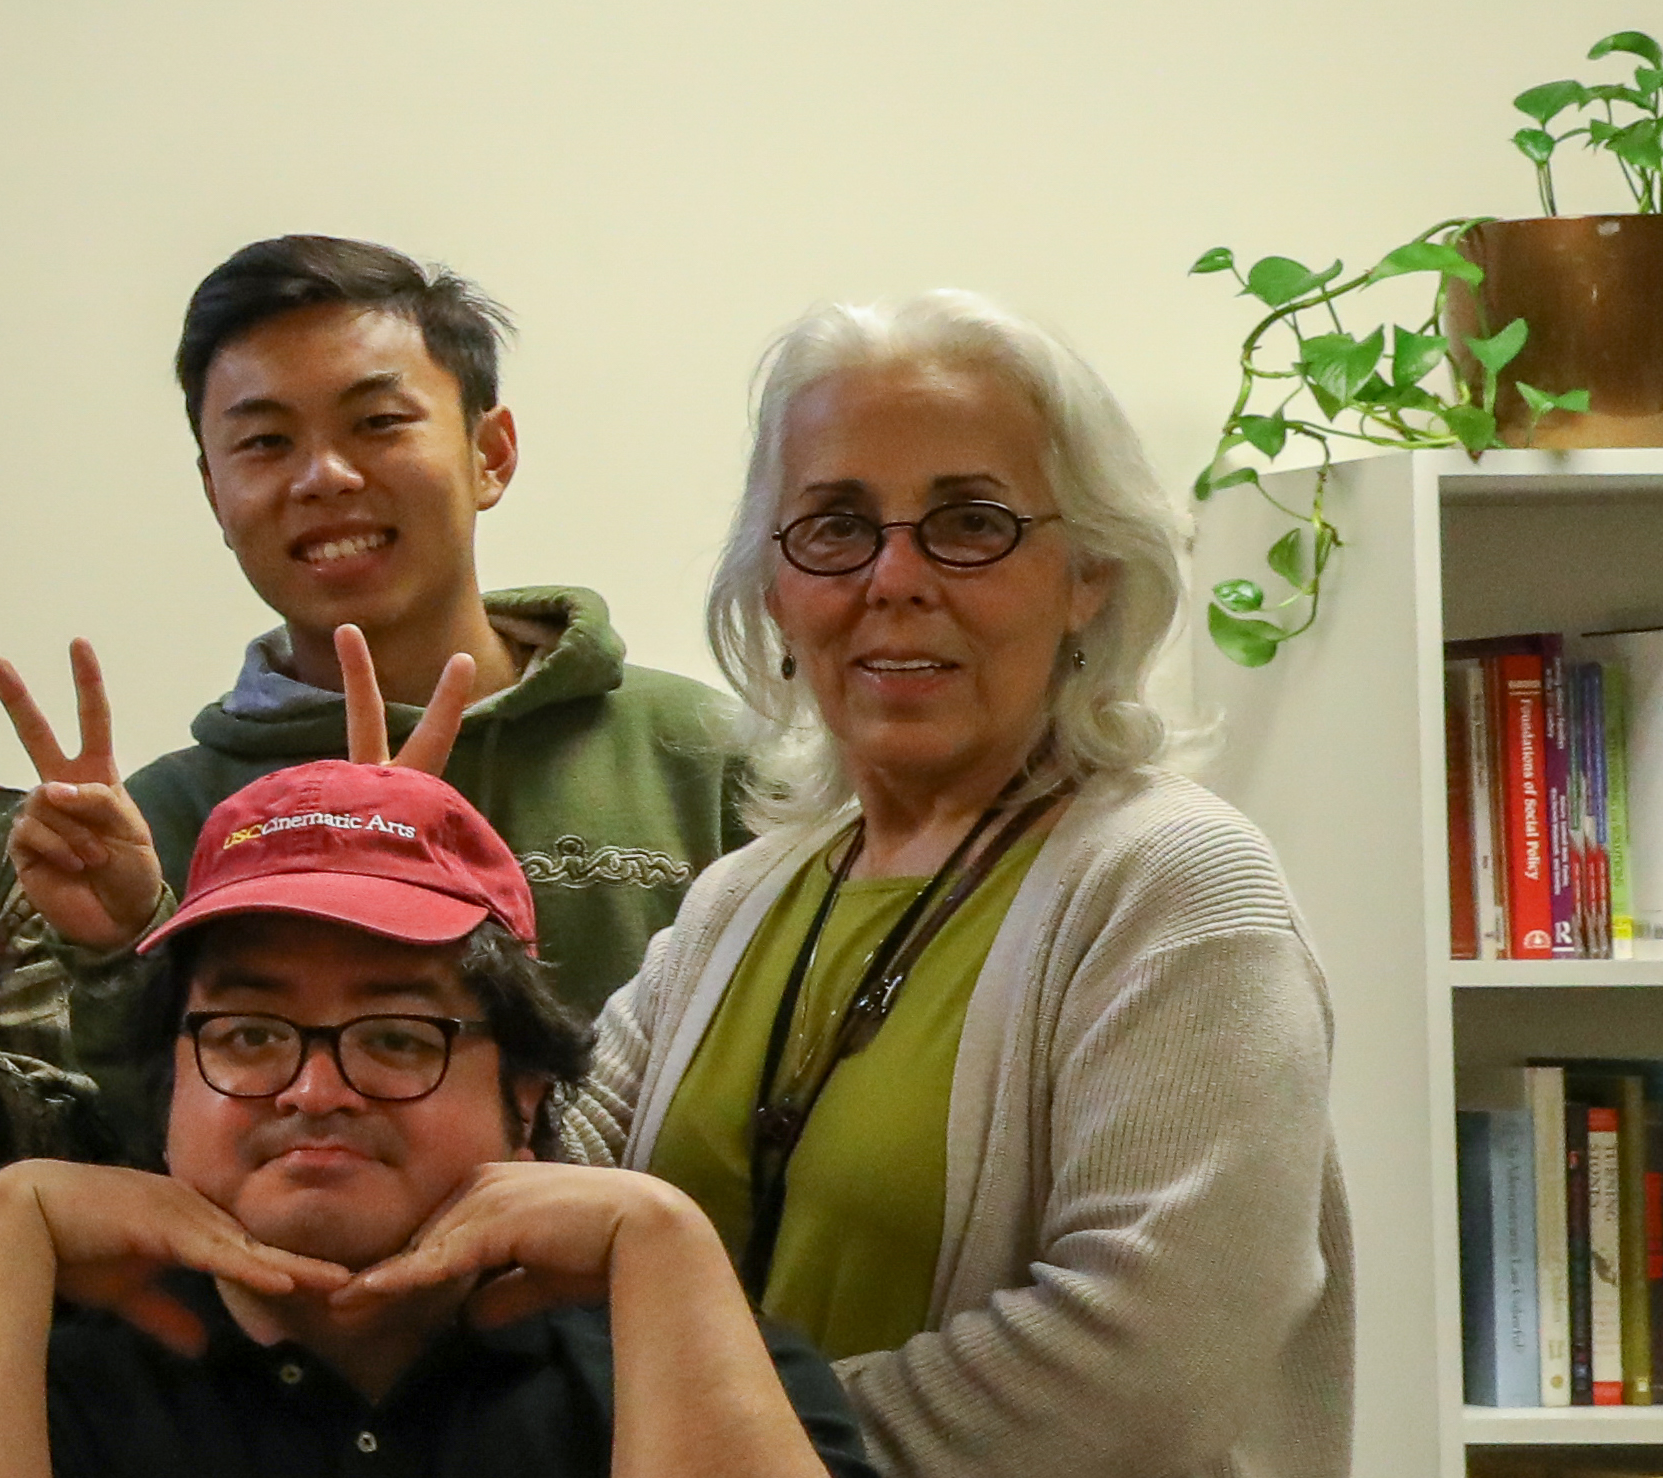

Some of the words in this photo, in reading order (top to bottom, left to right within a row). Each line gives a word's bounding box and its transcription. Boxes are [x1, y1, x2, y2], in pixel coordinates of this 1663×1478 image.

[1520, 699, 1535, 777] Foundations
[1523, 781, 1537, 796] of
[365, 814, 416, 839] Arts
[1524, 798, 1539, 838] Social
[1525, 840, 1541, 881] Policy
